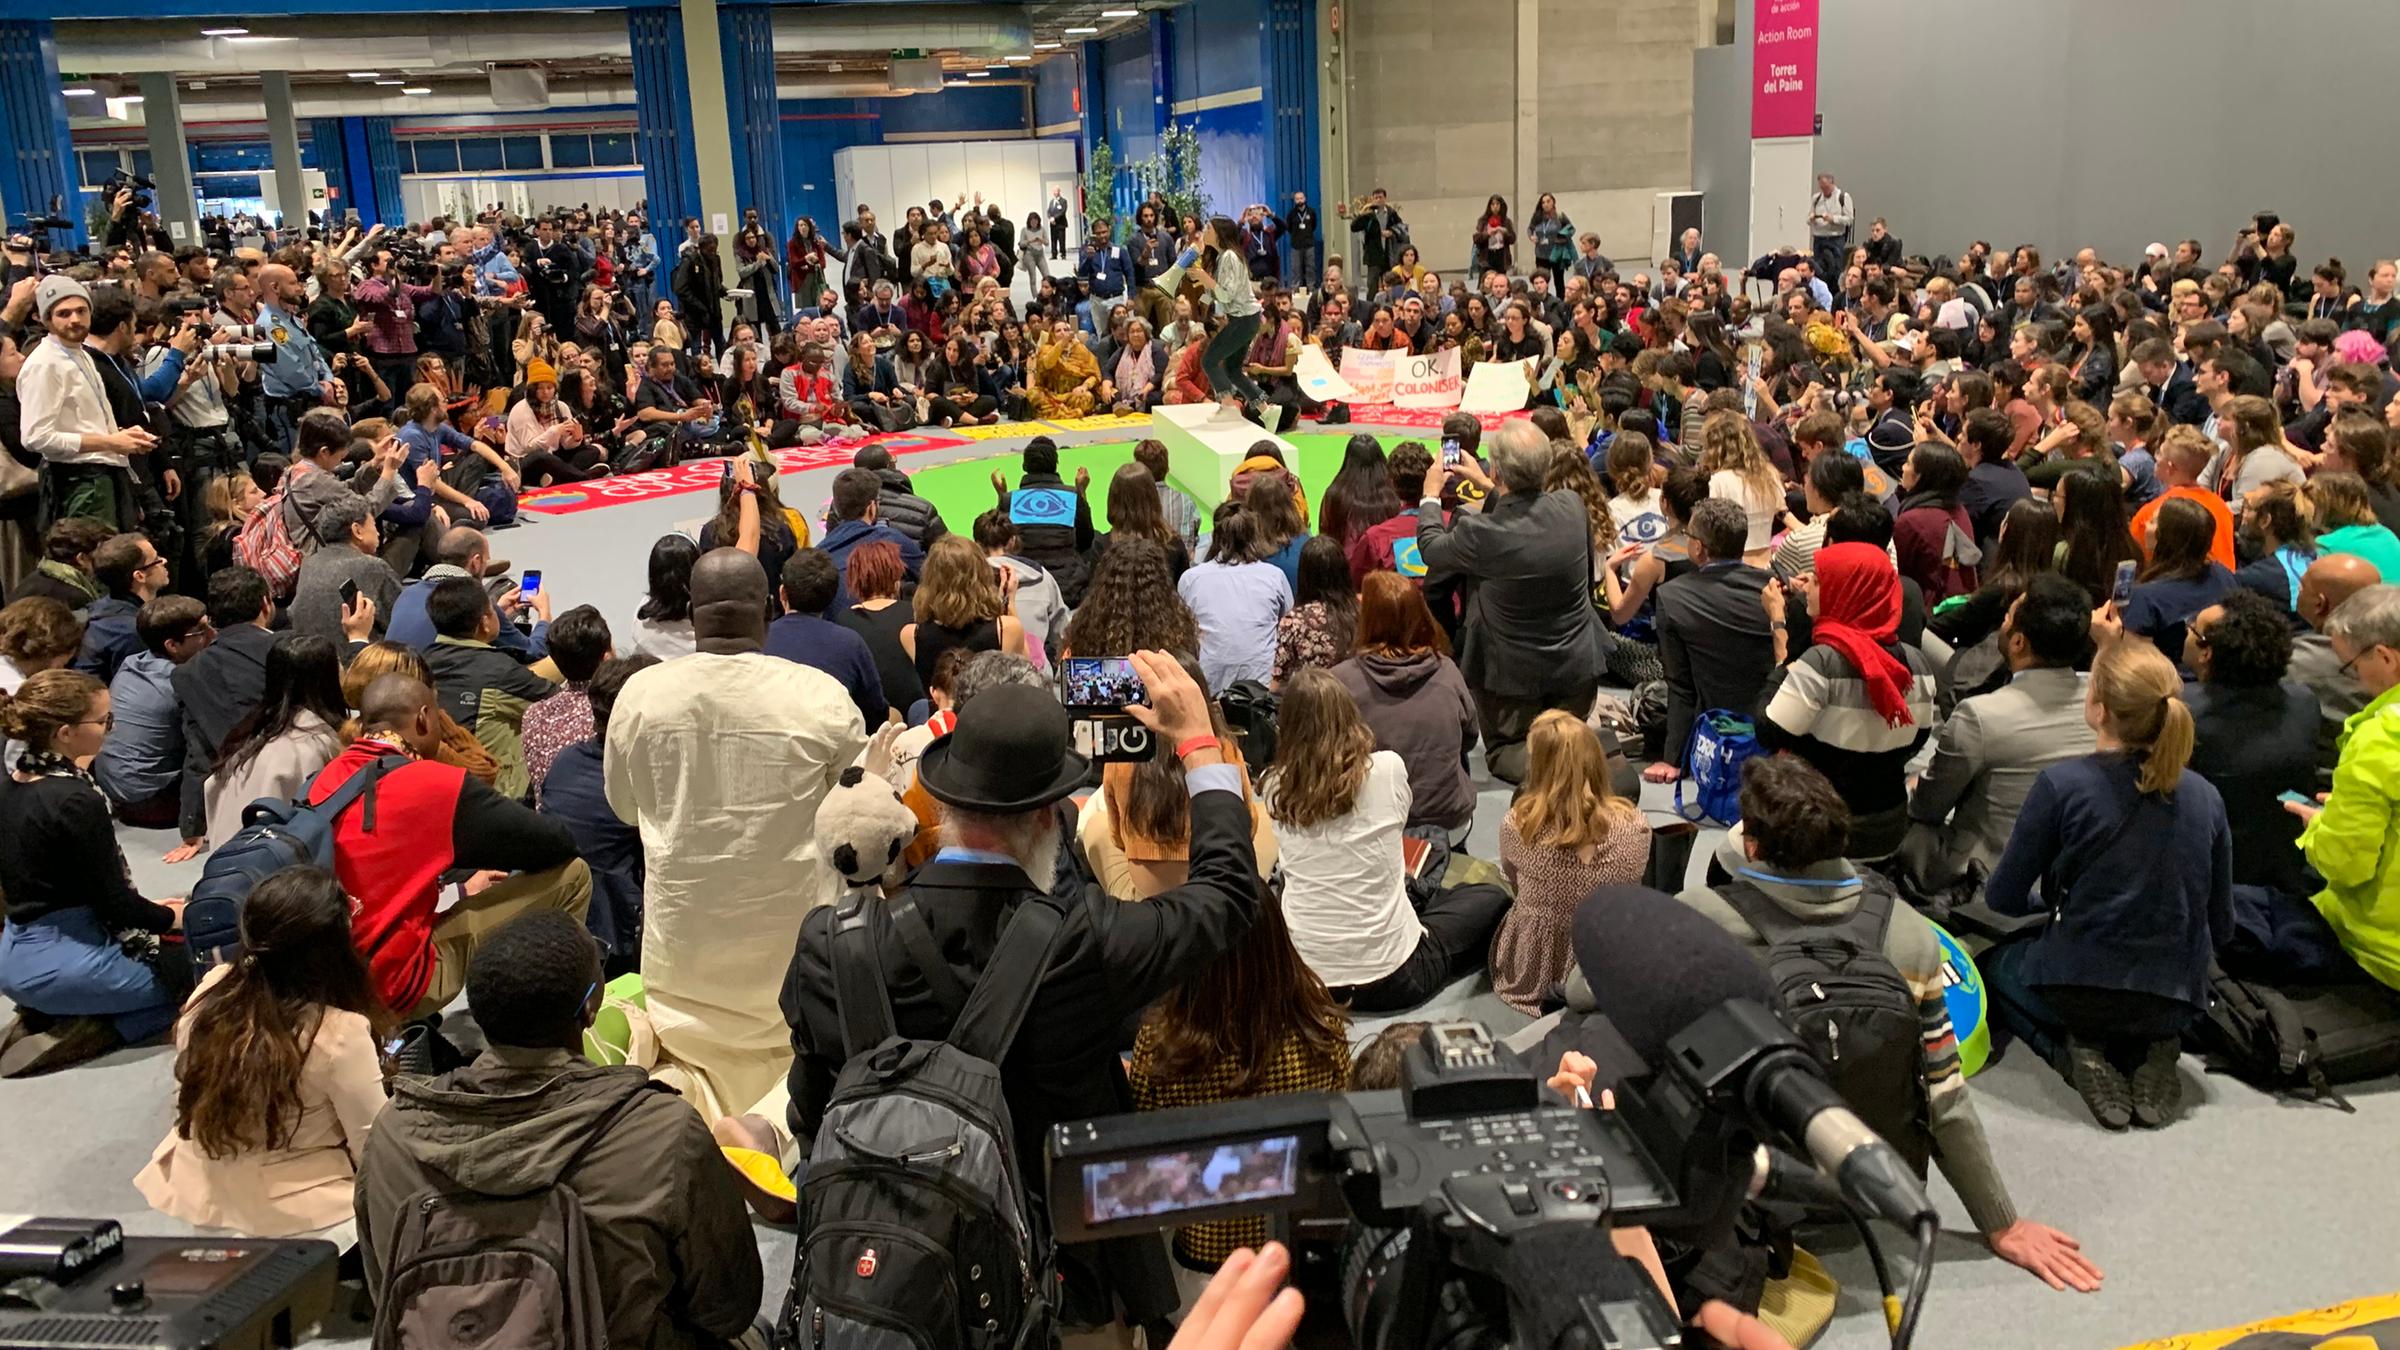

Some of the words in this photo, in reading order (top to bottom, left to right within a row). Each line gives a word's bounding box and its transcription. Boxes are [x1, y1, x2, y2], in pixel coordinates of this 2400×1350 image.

[1771, 3, 1779, 14] de
[1758, 31, 1785, 45] Action
[1786, 26, 1812, 40] Room
[1770, 64, 1797, 77] Torres
[1763, 80, 1777, 94] del
[1779, 78, 1803, 92] Paine
[1411, 358, 1444, 378] OK.
[1394, 374, 1460, 396] COLONISER
